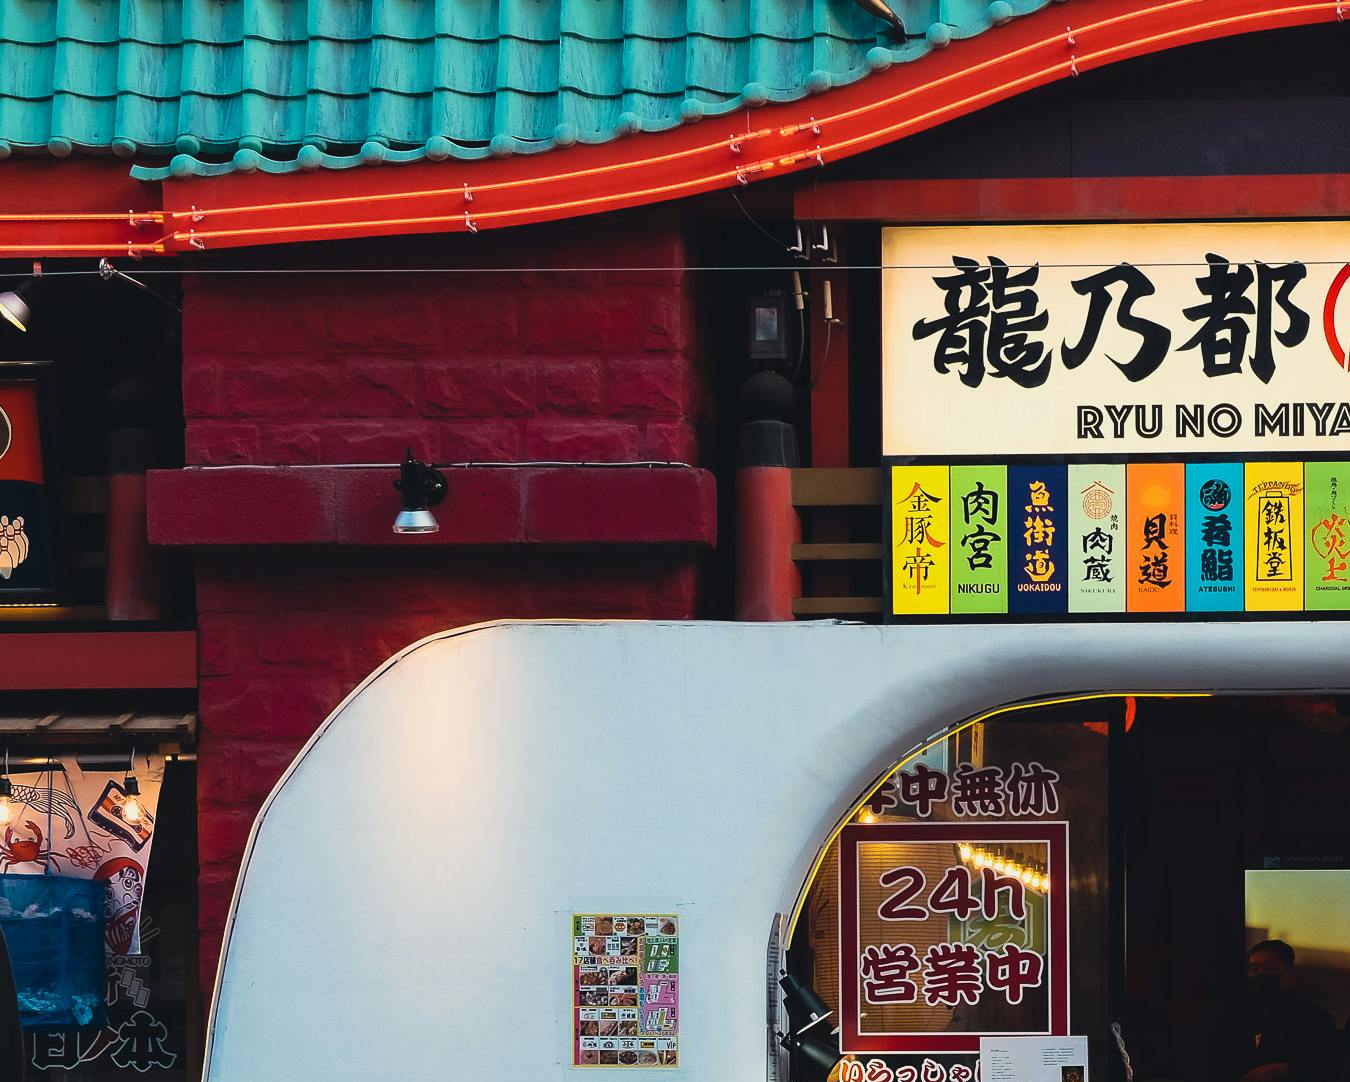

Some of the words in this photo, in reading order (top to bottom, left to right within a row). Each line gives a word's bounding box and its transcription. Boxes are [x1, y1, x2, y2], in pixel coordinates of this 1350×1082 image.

[912, 253, 1309, 389] 龍乃都
[1075, 402, 1166, 440] RYU
[1175, 402, 1243, 439] NO
[896, 481, 946, 595] 金豚帝
[961, 481, 1002, 571] 肉宮
[1023, 480, 1056, 582] 魚街道
[1081, 526, 1114, 583] 肉蔵
[1137, 512, 1173, 589] 貝道
[957, 583, 1000, 594] NIKUGU
[1017, 583, 1062, 592] UOKAIDOU
[876, 865, 1026, 922] 24h
[105, 955, 152, 968] INOMOTO
[861, 943, 1045, 1006] 営業中
